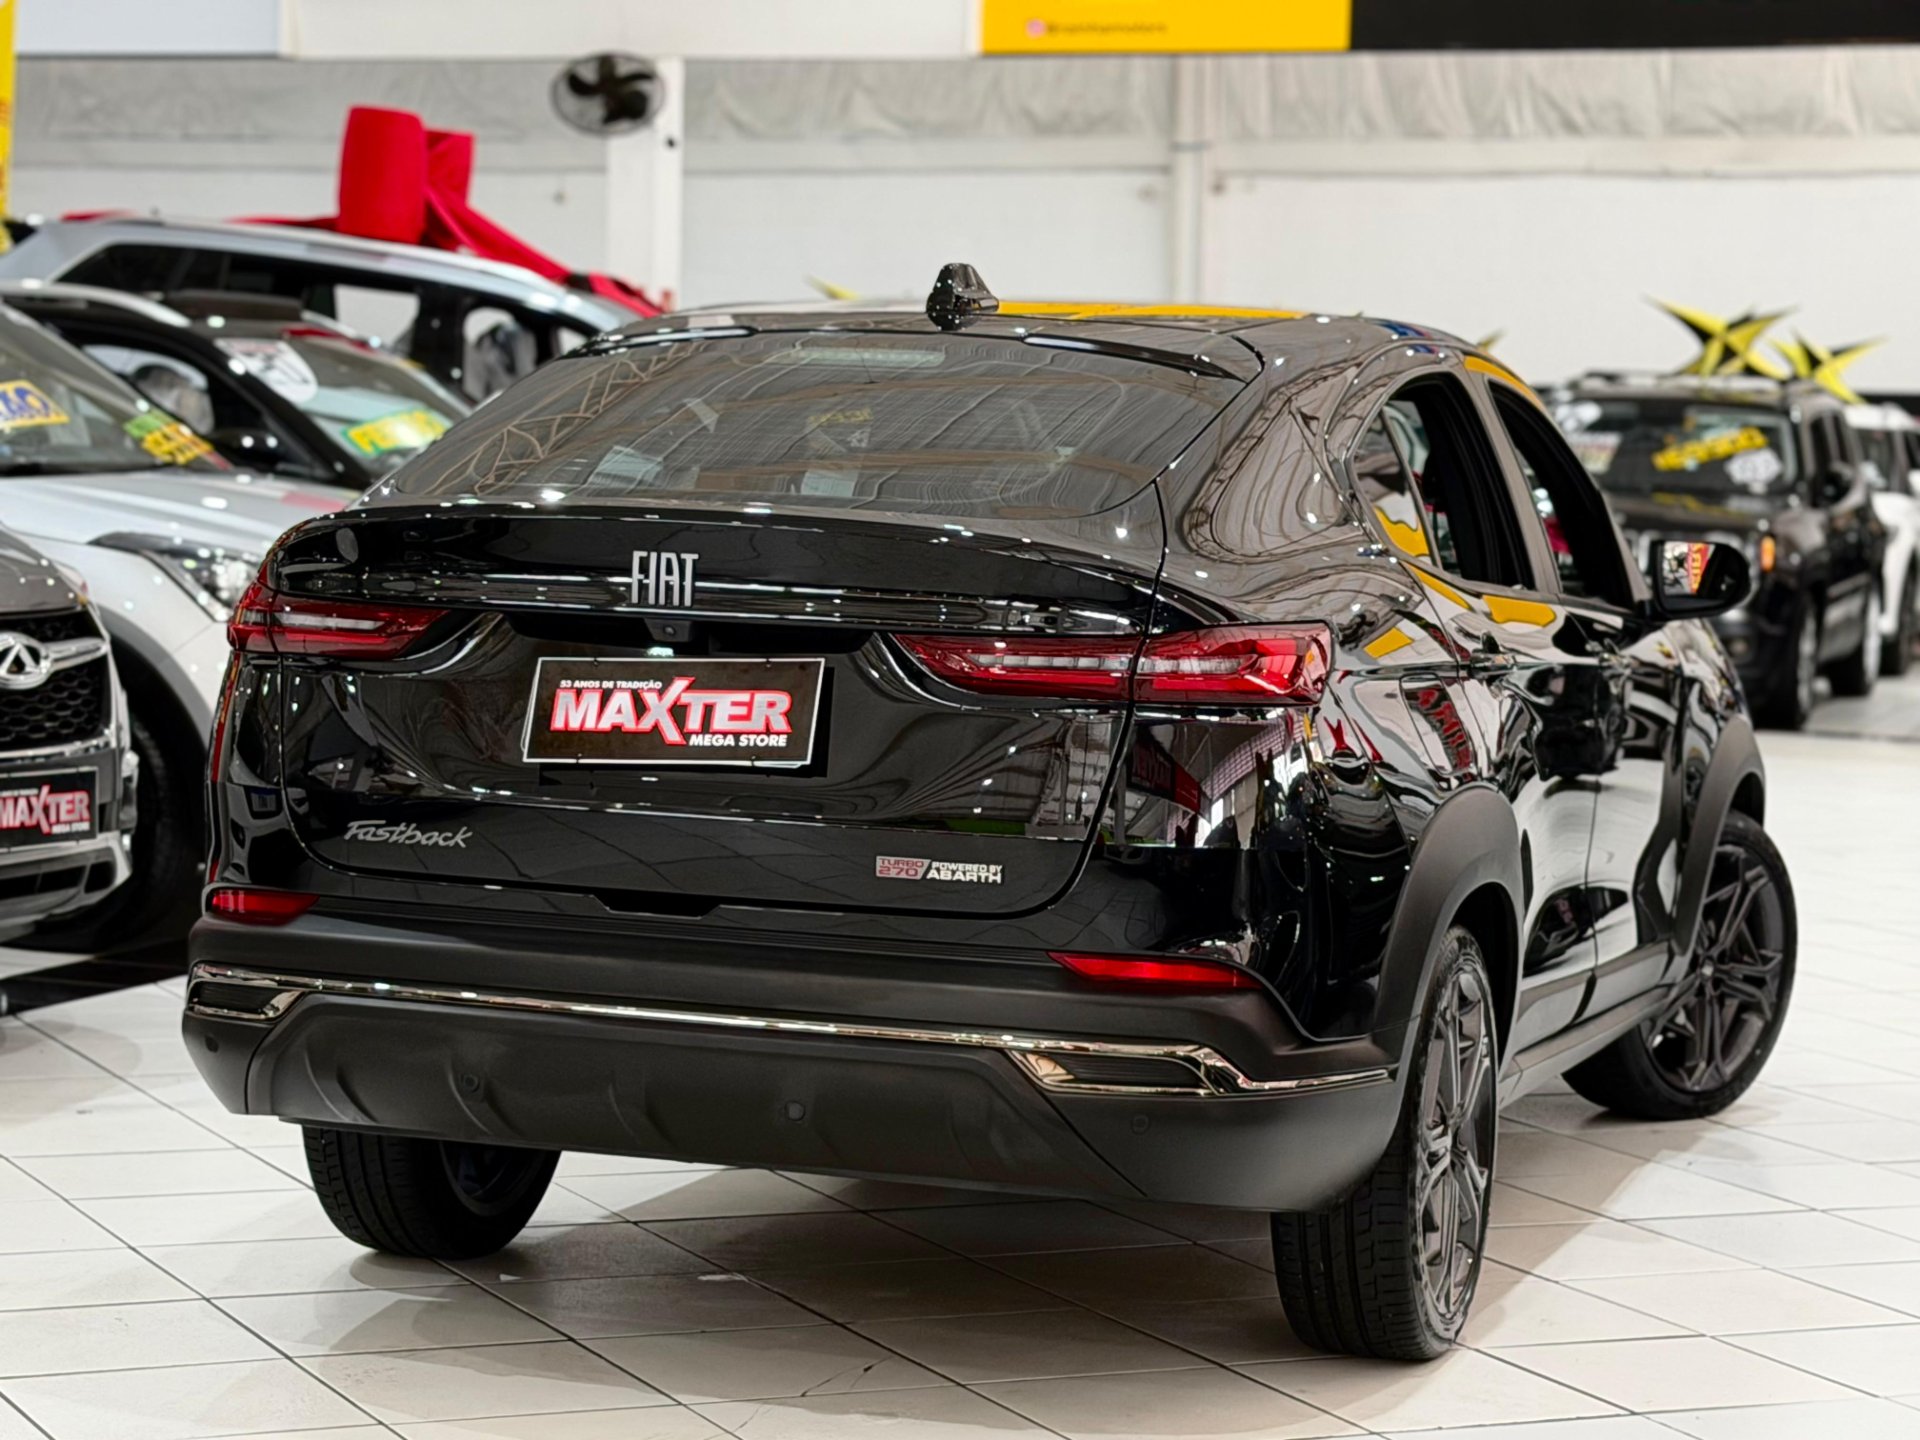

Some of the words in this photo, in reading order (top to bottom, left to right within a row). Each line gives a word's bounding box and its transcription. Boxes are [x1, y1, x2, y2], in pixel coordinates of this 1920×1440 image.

[632, 550, 699, 607] FIAT
[559, 679, 572, 688] 53
[573, 680, 600, 688] ANOS
[602, 680, 614, 688] DE
[616, 679, 663, 690] TRADIÇÃO
[550, 676, 792, 745] MAXTER
[688, 733, 735, 747] MEGA
[739, 734, 788, 747] STORE
[343, 820, 473, 848] Fastback
[881, 858, 925, 868] TURBO
[931, 861, 987, 873] POWERED
[989, 864, 1003, 873] BY
[878, 866, 919, 877] 270
[926, 869, 1002, 884] ABARTH
